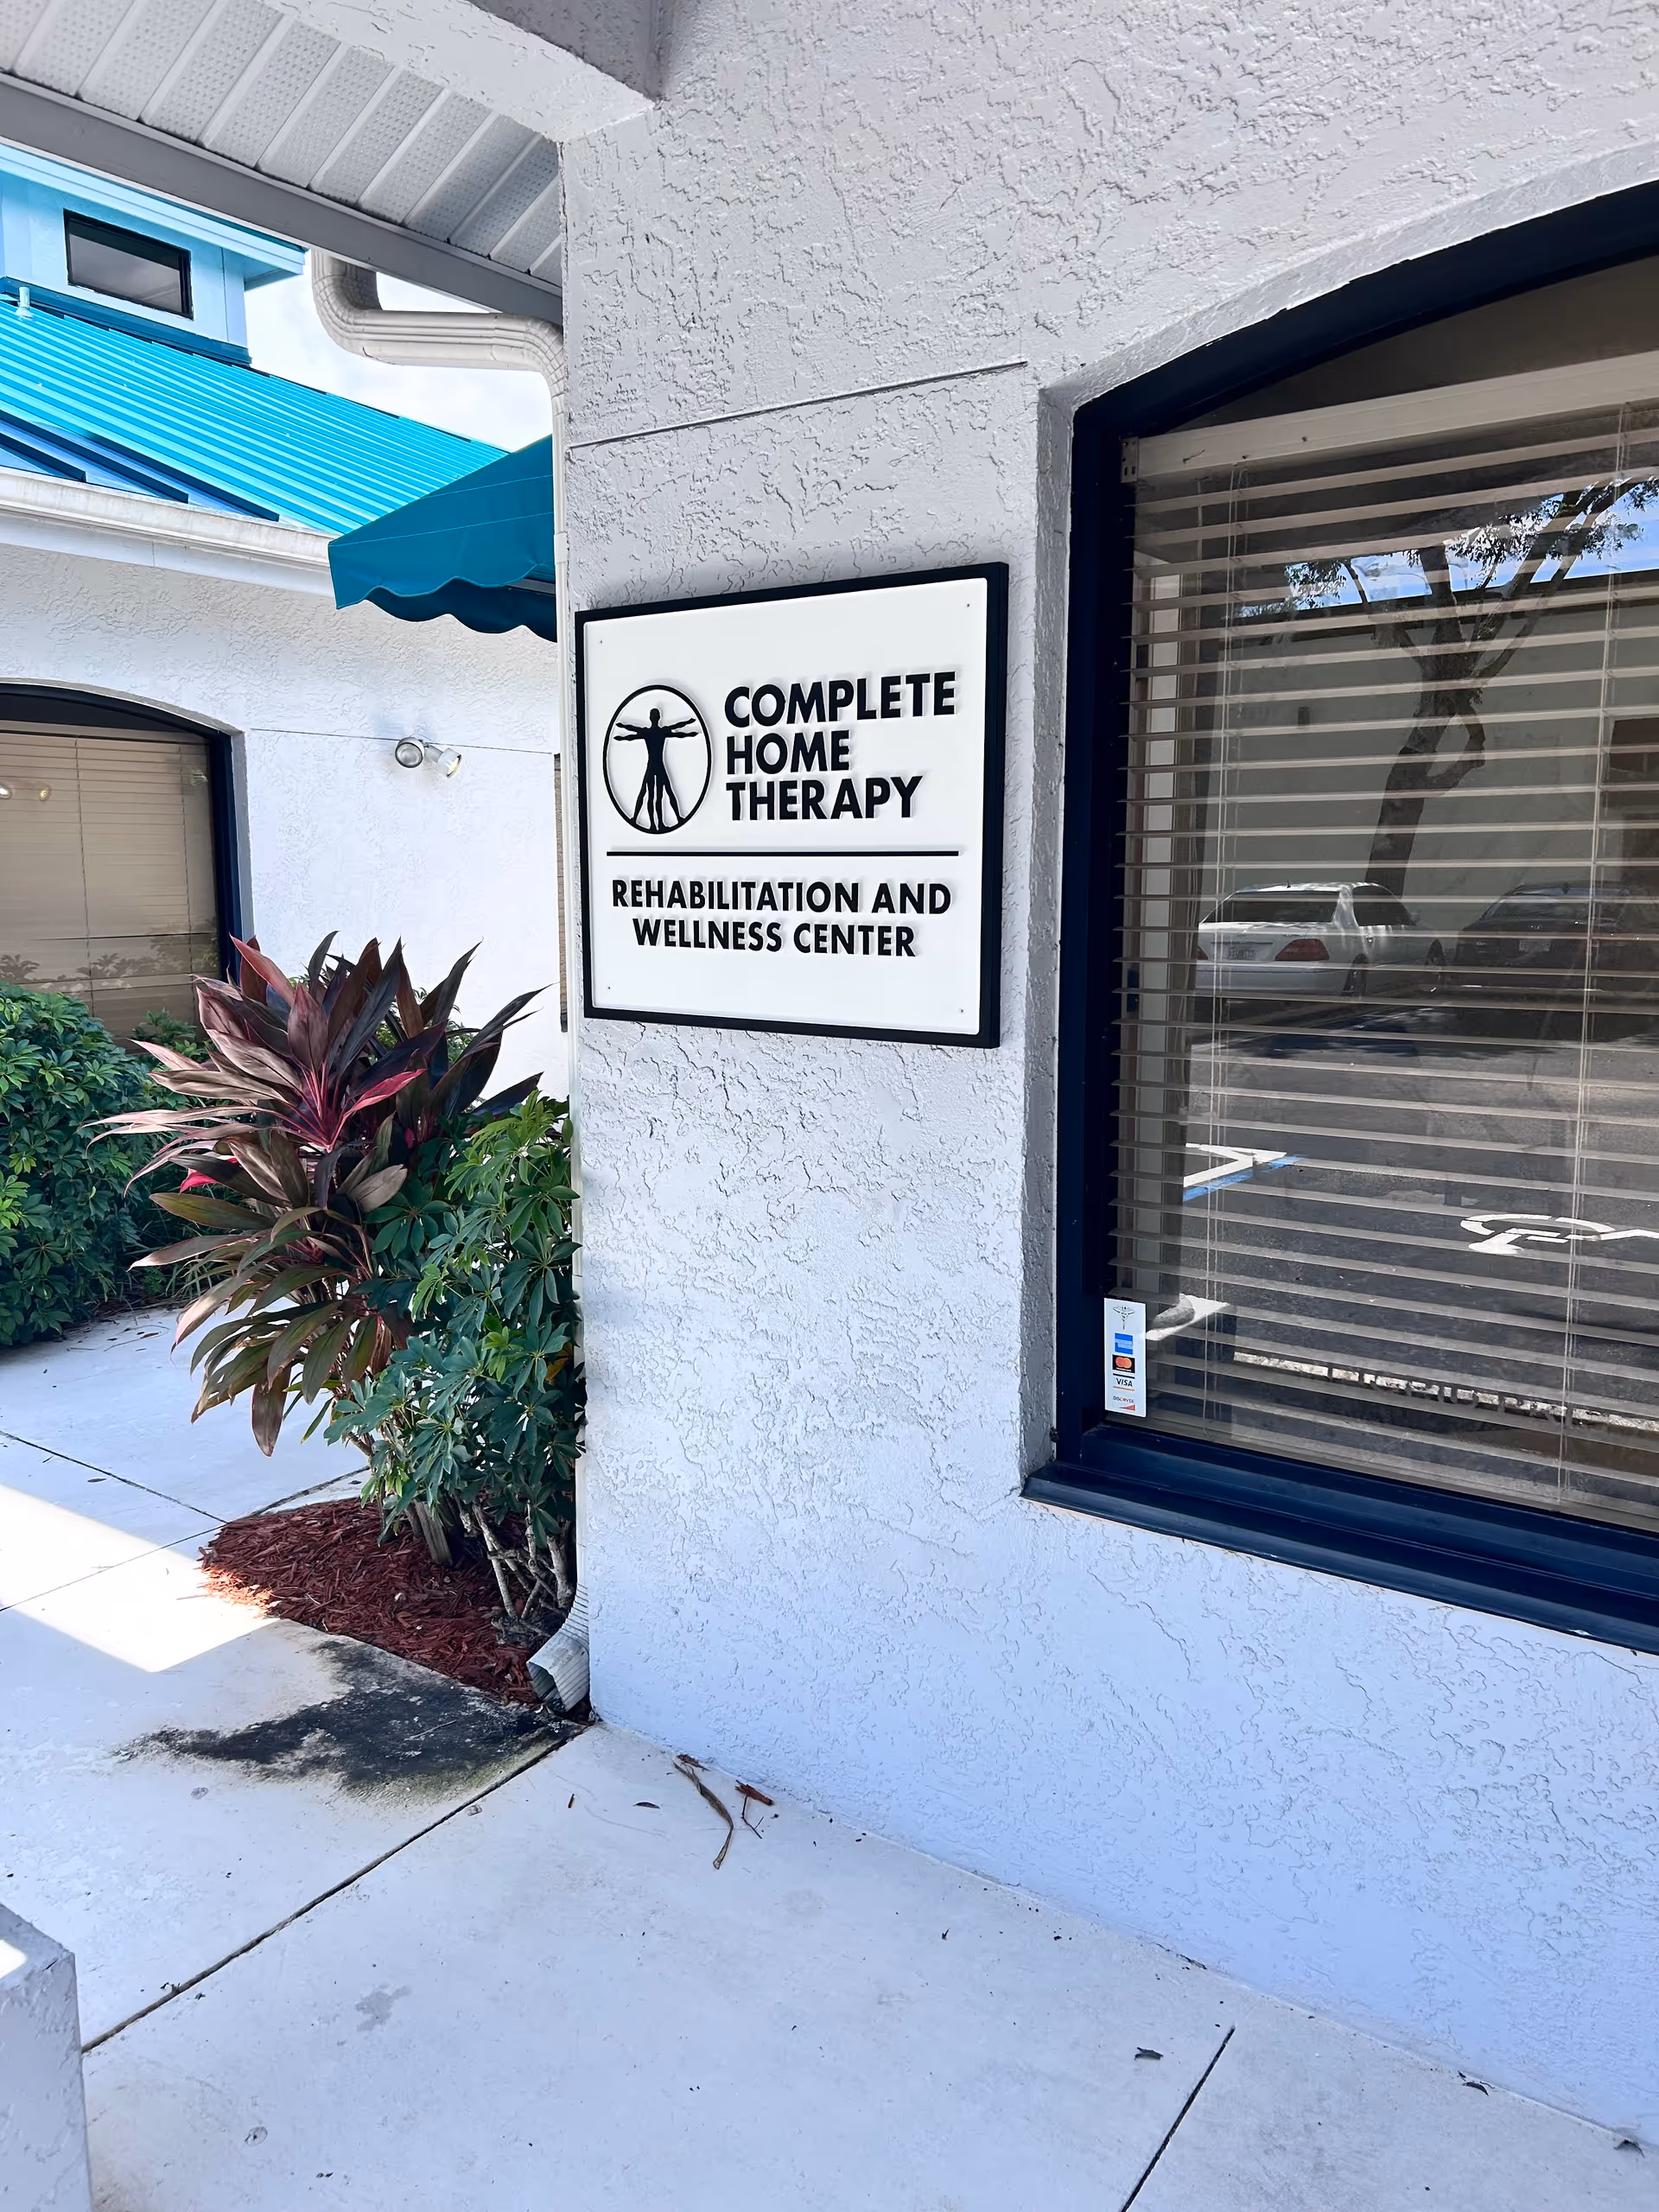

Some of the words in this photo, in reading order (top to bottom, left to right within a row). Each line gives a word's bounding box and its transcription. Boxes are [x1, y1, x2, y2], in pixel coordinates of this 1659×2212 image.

[724, 671, 956, 728] COMPLETE
[727, 729, 850, 775] HOME
[726, 775, 923, 821] THERAPY
[612, 880, 859, 913] REHABILITATION
[871, 882, 951, 914] AND
[632, 918, 782, 952] WELLNESS
[793, 923, 916, 957] CENTER
[1116, 1377, 1133, 1387] VISA
